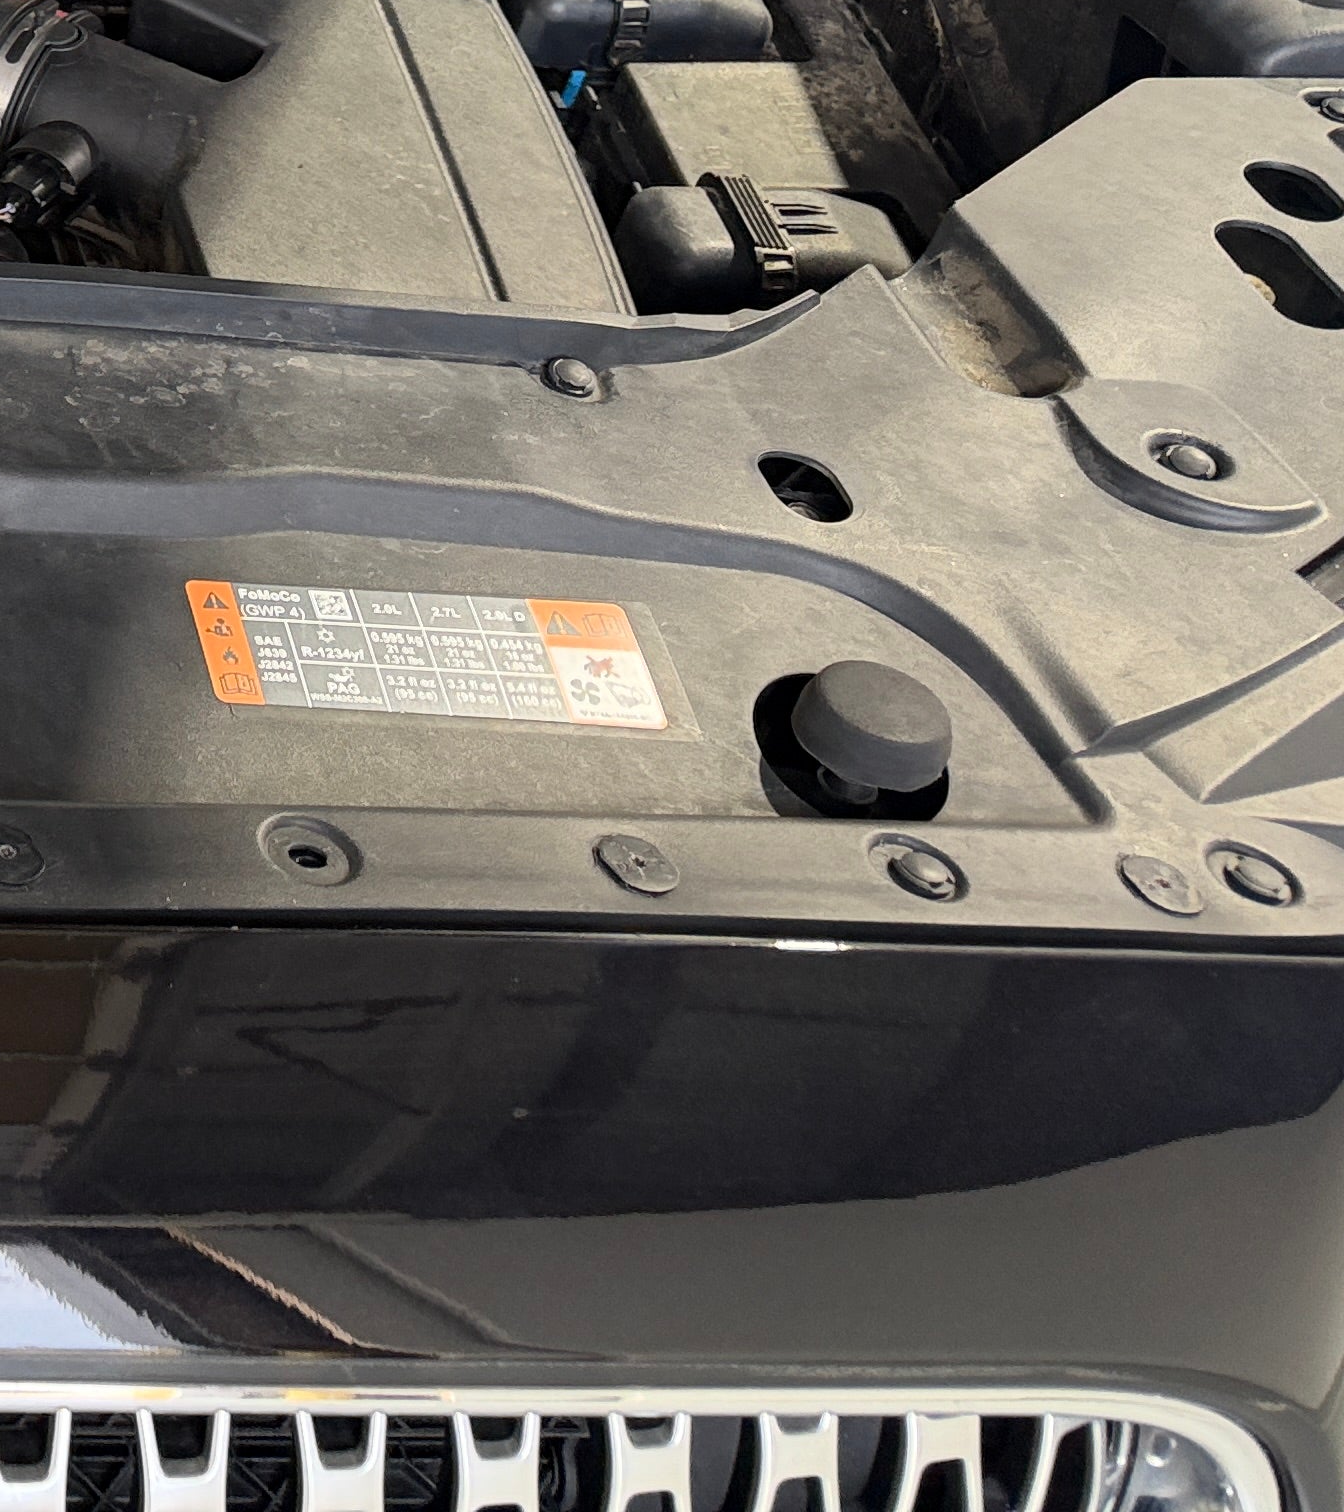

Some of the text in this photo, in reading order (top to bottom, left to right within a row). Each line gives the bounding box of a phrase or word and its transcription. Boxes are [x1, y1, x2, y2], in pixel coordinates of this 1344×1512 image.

[238, 588, 301, 602] FoMoCo
[240, 604, 306, 620] (GWP 4)
[430, 607, 462, 618] 2.7L
[327, 681, 361, 695] PAG
